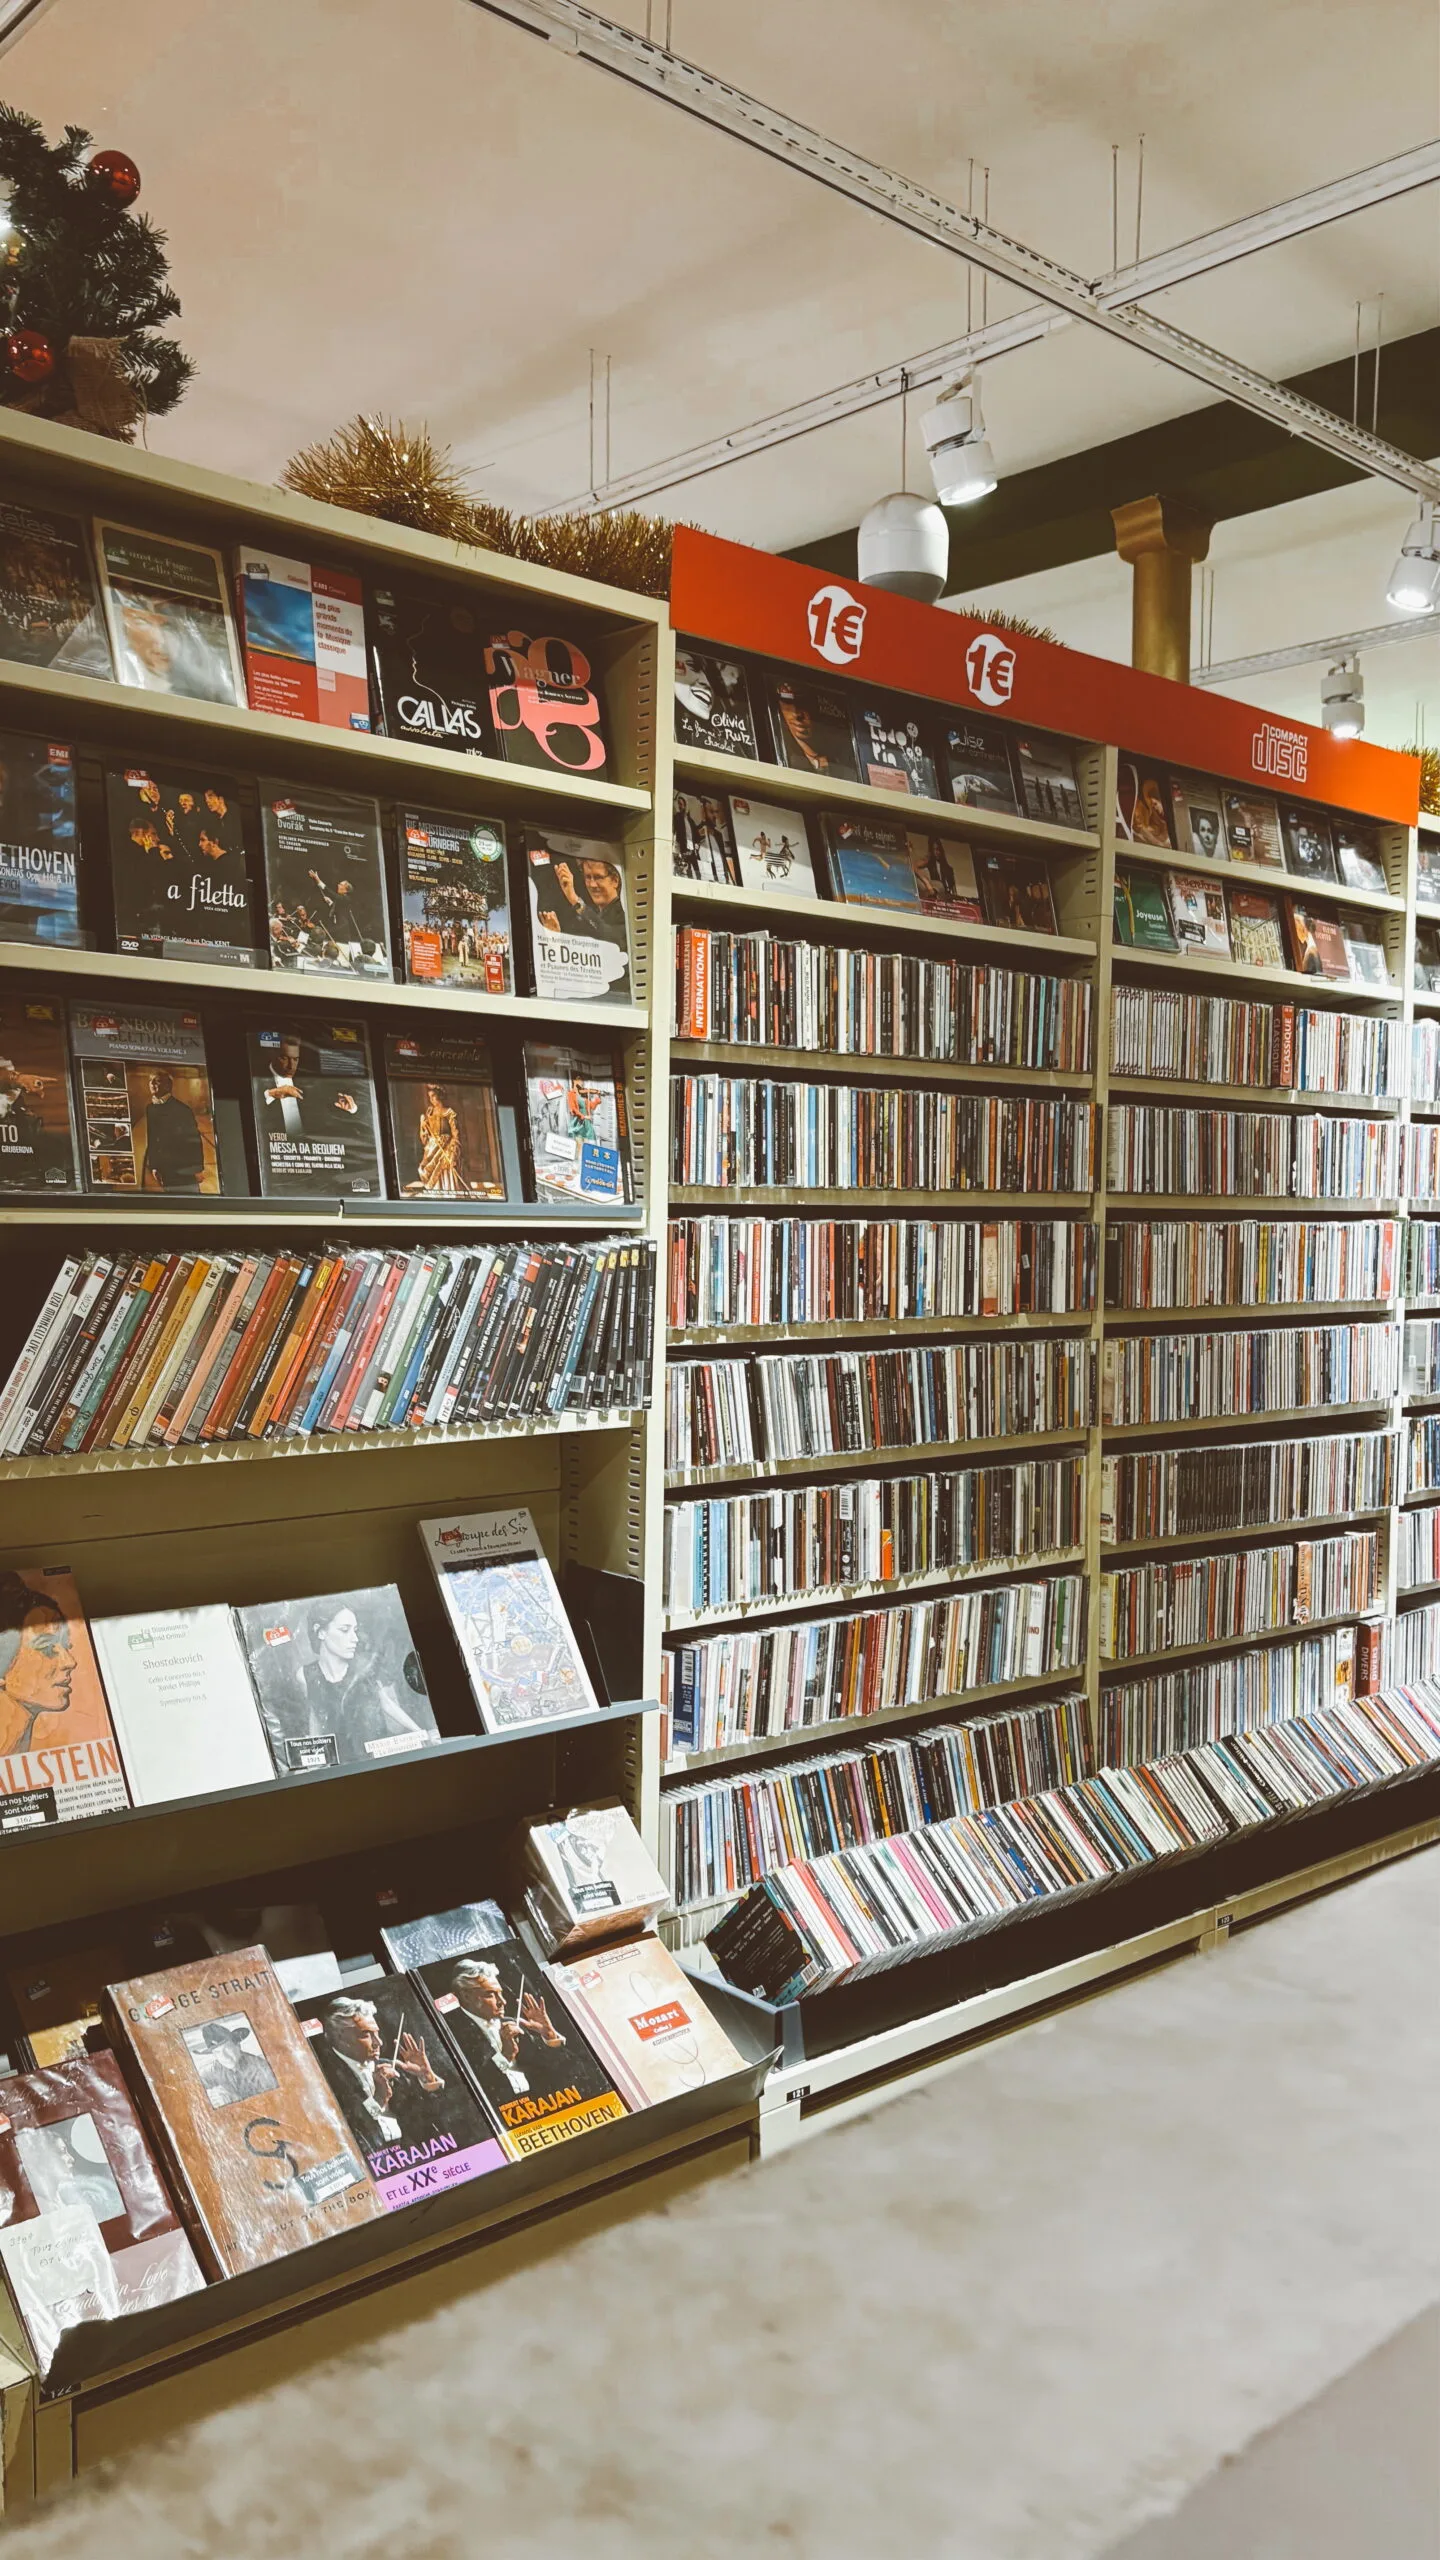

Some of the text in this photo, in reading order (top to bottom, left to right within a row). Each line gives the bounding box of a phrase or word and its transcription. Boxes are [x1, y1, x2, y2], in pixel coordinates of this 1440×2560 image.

[313, 581, 328, 591] EMI
[315, 600, 342, 614] Les plus
[316, 612, 337, 623] grands
[810, 596, 864, 656] 1€
[317, 622, 353, 636] moments de
[318, 642, 347, 656] classique
[500, 656, 581, 690] Wagner
[968, 644, 1014, 696] 1€
[397, 695, 482, 739] CALLAS
[711, 713, 747, 731] Olivia
[704, 738, 735, 754] chocolat
[1269, 726, 1308, 747] COMPACT
[49, 748, 70, 759] EMI
[278, 819, 304, 832] Dvořák
[406, 819, 471, 841] DIE MEISTERSINGER
[428, 836, 460, 852] ÜRNBERG
[167, 873, 248, 911] a filetta
[1136, 909, 1164, 922] Joyeuse
[121, 940, 139, 952] DVD
[538, 942, 602, 968] Te Deum
[695, 941, 705, 1028] INTERNATIONAL
[76, 1013, 176, 1034] BNBOIM
[108, 1031, 200, 1048] BEETHOVEN
[1273, 1018, 1281, 1074] CLASSIQUE
[1284, 1017, 1292, 1074] CLASSIQUE
[269, 1132, 287, 1142] VERDI
[2, 1145, 34, 1154] GRUBEROVA
[270, 1142, 345, 1156] MESSA DA REQUIEM
[88, 1312, 104, 1335] KARAJAN
[476, 1293, 504, 1362] THE SLEEPING BEAUTY
[492, 1517, 529, 1538] des Six
[143, 1653, 204, 1671] Shostakovich
[1361, 1646, 1369, 1681] DIVERS
[148, 1675, 164, 1685] Cello
[165, 1674, 192, 1684] Concerto
[159, 1696, 191, 1708] Symphony
[9, 1796, 25, 1807] nos
[26, 1791, 49, 1802] boîtiers
[4, 1804, 40, 1815] sont vides
[128, 1970, 269, 2023] GRGE STRAIT
[633, 2008, 680, 2031] Mozart
[792, 2088, 805, 2098] 121
[502, 2085, 582, 2127] KARAJAN
[517, 2104, 615, 2154] BEETHOVEN
[369, 2132, 459, 2177] KARAJAN
[386, 2190, 398, 2201] ET
[399, 2186, 410, 2197] LE
[442, 2162, 472, 2180] SIÈCLE
[347, 2188, 372, 2205] BOX
[132, 2262, 168, 2293] Love
